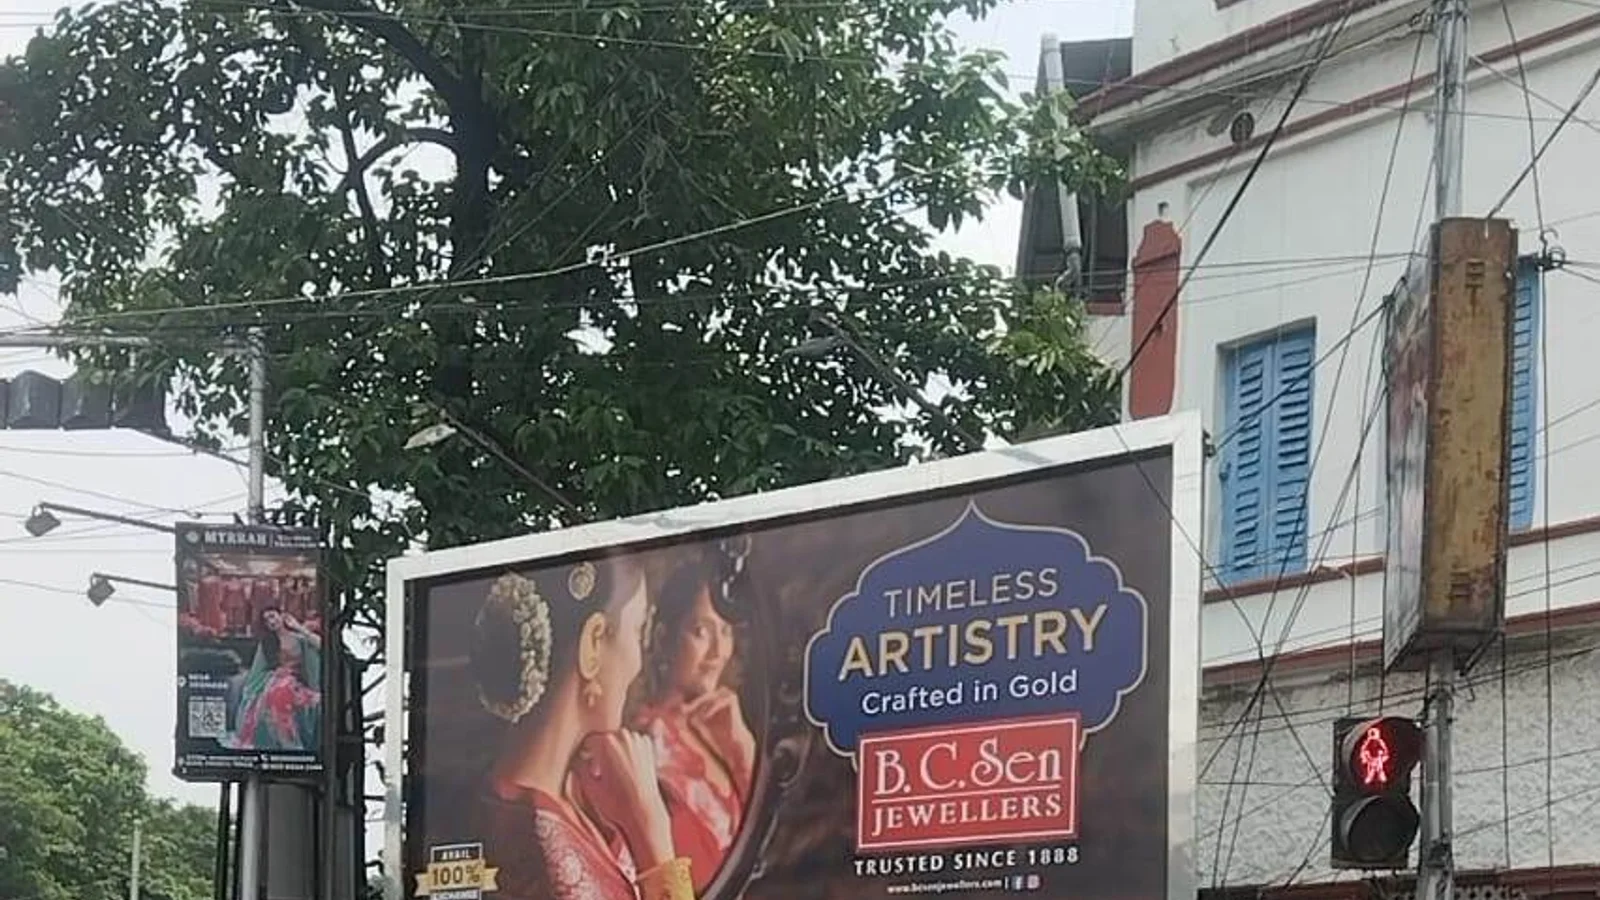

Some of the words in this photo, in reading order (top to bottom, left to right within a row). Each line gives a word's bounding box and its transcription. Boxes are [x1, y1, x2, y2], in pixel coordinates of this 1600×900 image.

[883, 568, 1059, 618] TIMELESS
[838, 604, 1108, 681] ARTISTRY
[862, 682, 963, 715] Crafted
[974, 679, 998, 703] in
[1009, 669, 1078, 698] Gold
[872, 794, 1062, 836] JEWELLERS
[432, 864, 480, 886] 100%
[854, 854, 944, 876] TRUSTED
[953, 850, 1016, 870] SINCE
[1028, 847, 1079, 866] 1888
